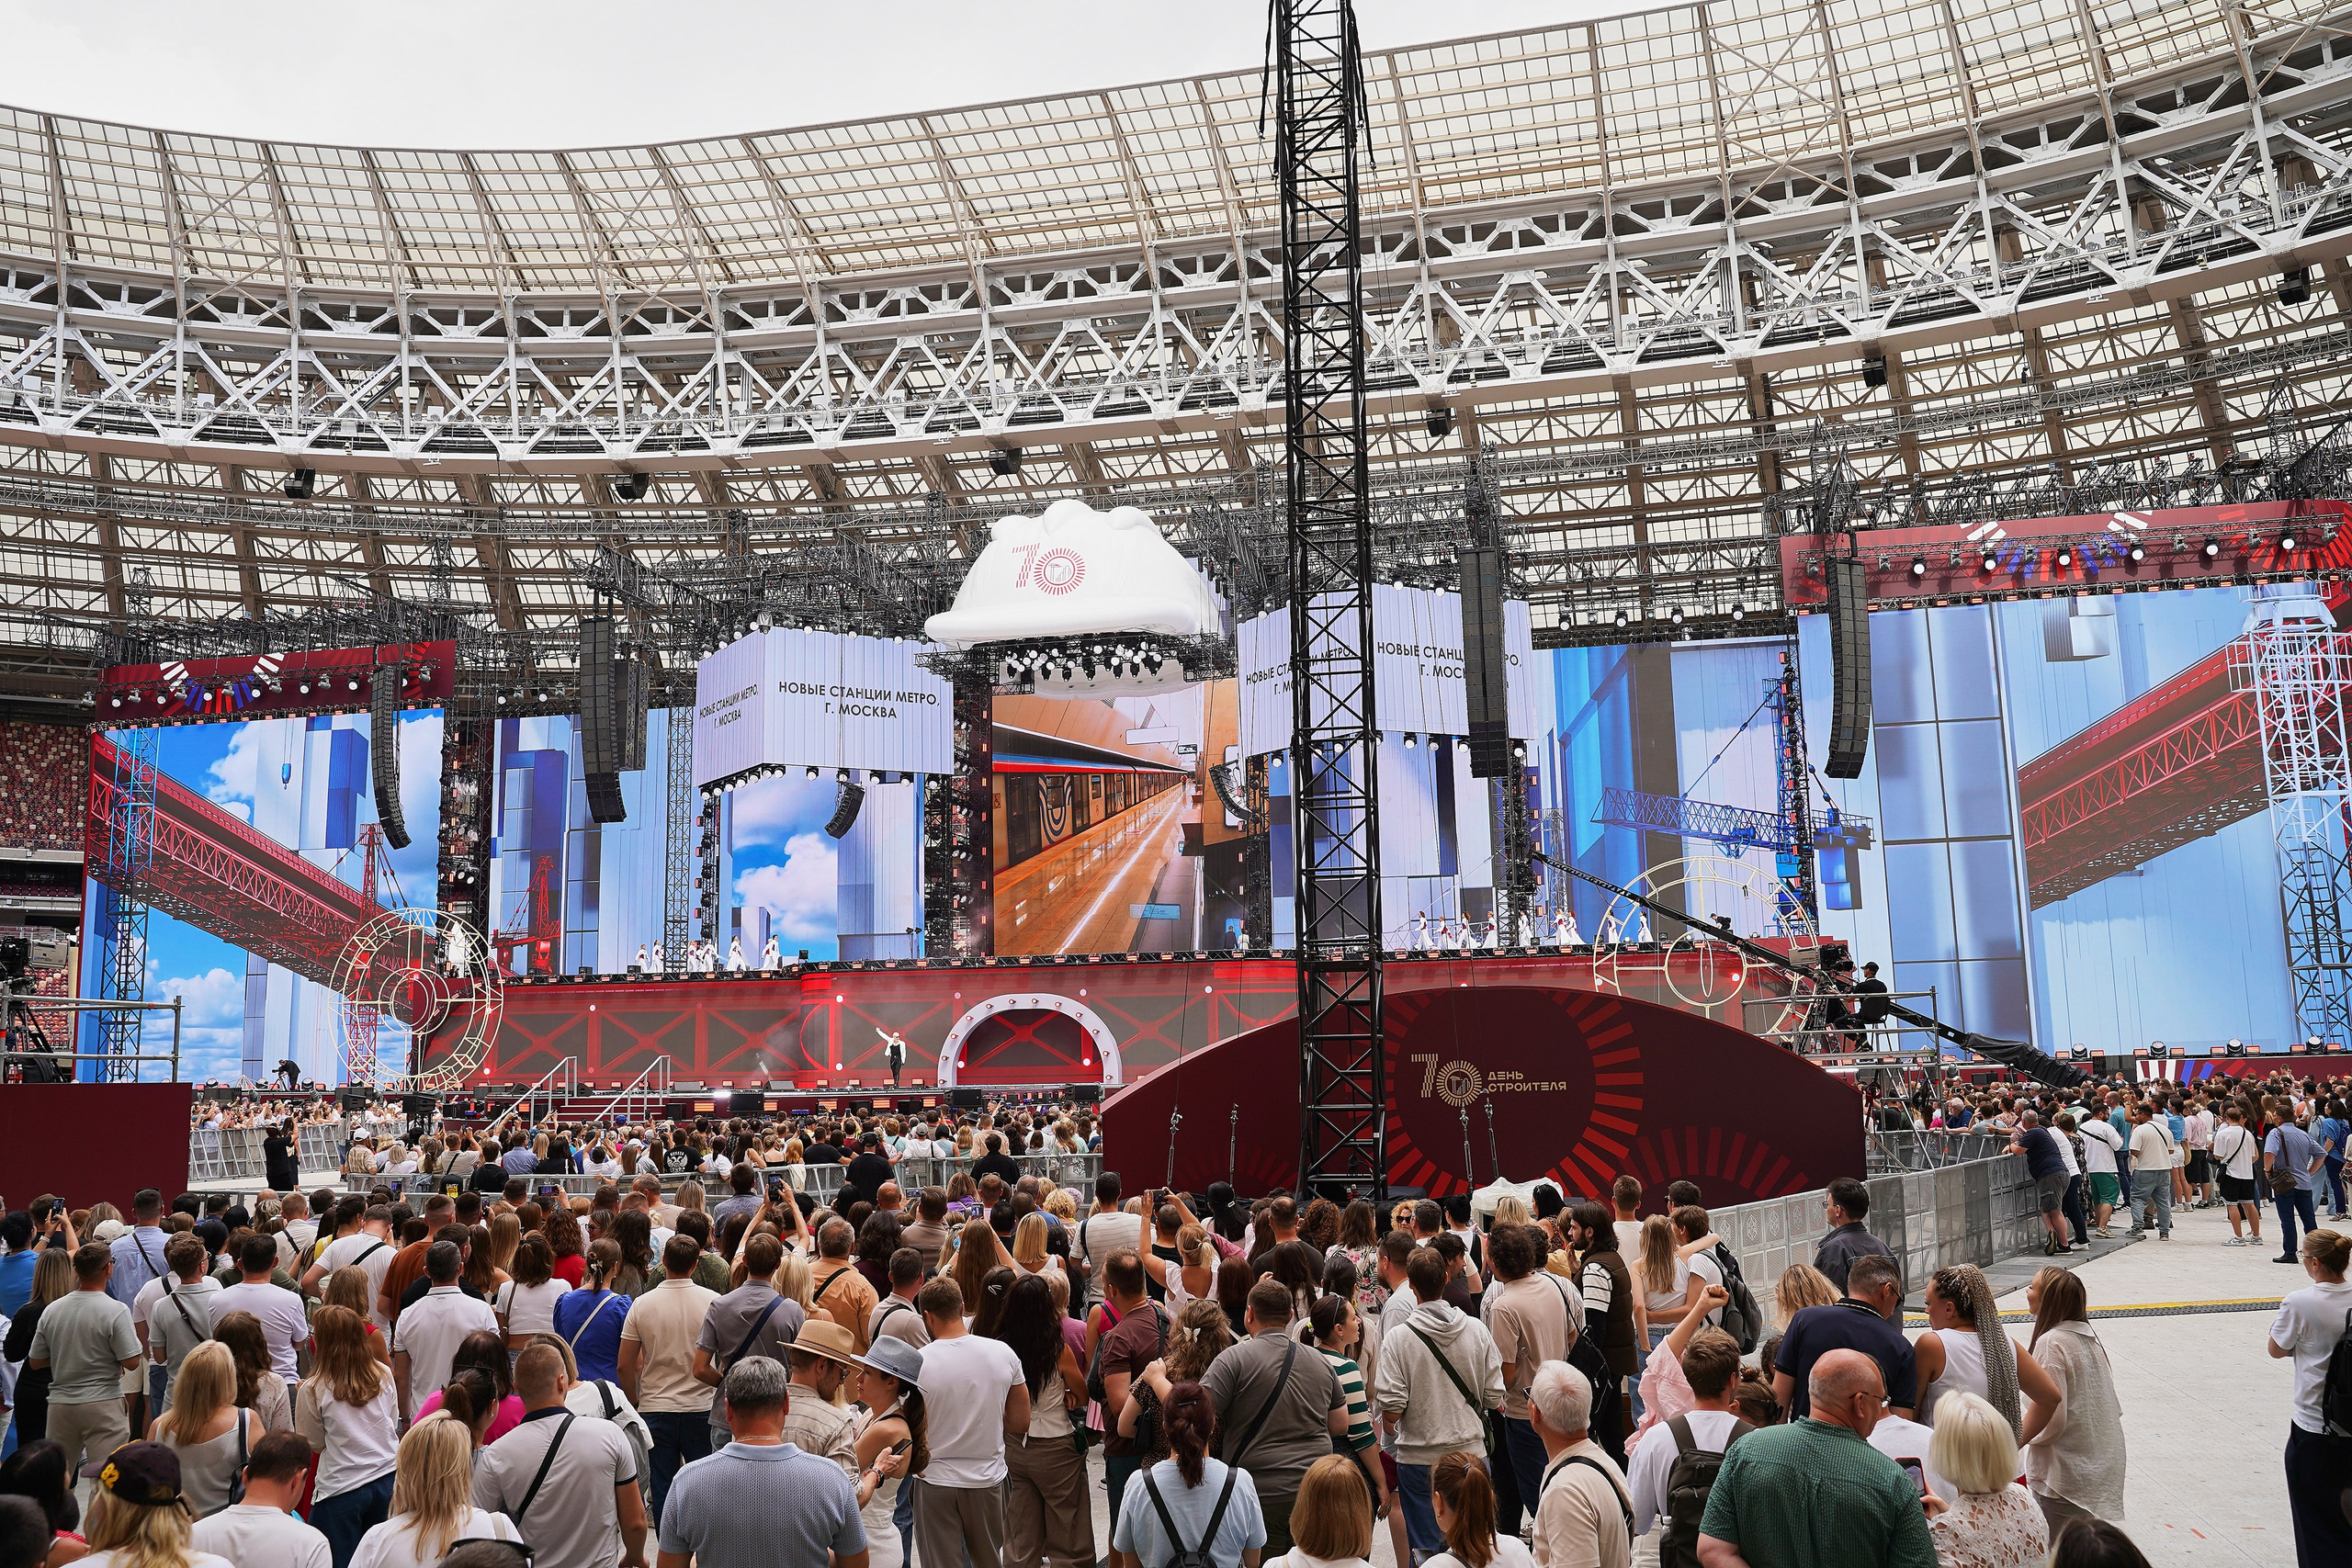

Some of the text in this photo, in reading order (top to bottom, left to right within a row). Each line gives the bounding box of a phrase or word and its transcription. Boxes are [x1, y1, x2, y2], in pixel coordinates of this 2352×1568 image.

[1377, 641, 1420, 657] НОВЫЕ
[1423, 646, 1465, 662] СТАНЦ
[1246, 667, 1274, 686] НОВЫЕ
[1420, 664, 1465, 680] Г. МОС
[779, 681, 941, 706] НОВЫЕ СТАНЦИИ МЕТРО,
[1273, 683, 1281, 694] Г.
[699, 683, 759, 719] НОВЫЕ СТАНЦИИ МЕТРО,
[718, 708, 741, 728] МОСКВА
[825, 703, 897, 719] Г. МОСКВА
[1487, 1071, 1524, 1080] ДЕНЬ
[1487, 1081, 1567, 1092] СТРОИТЕЛЯ
[101, 1462, 119, 1488] 82
